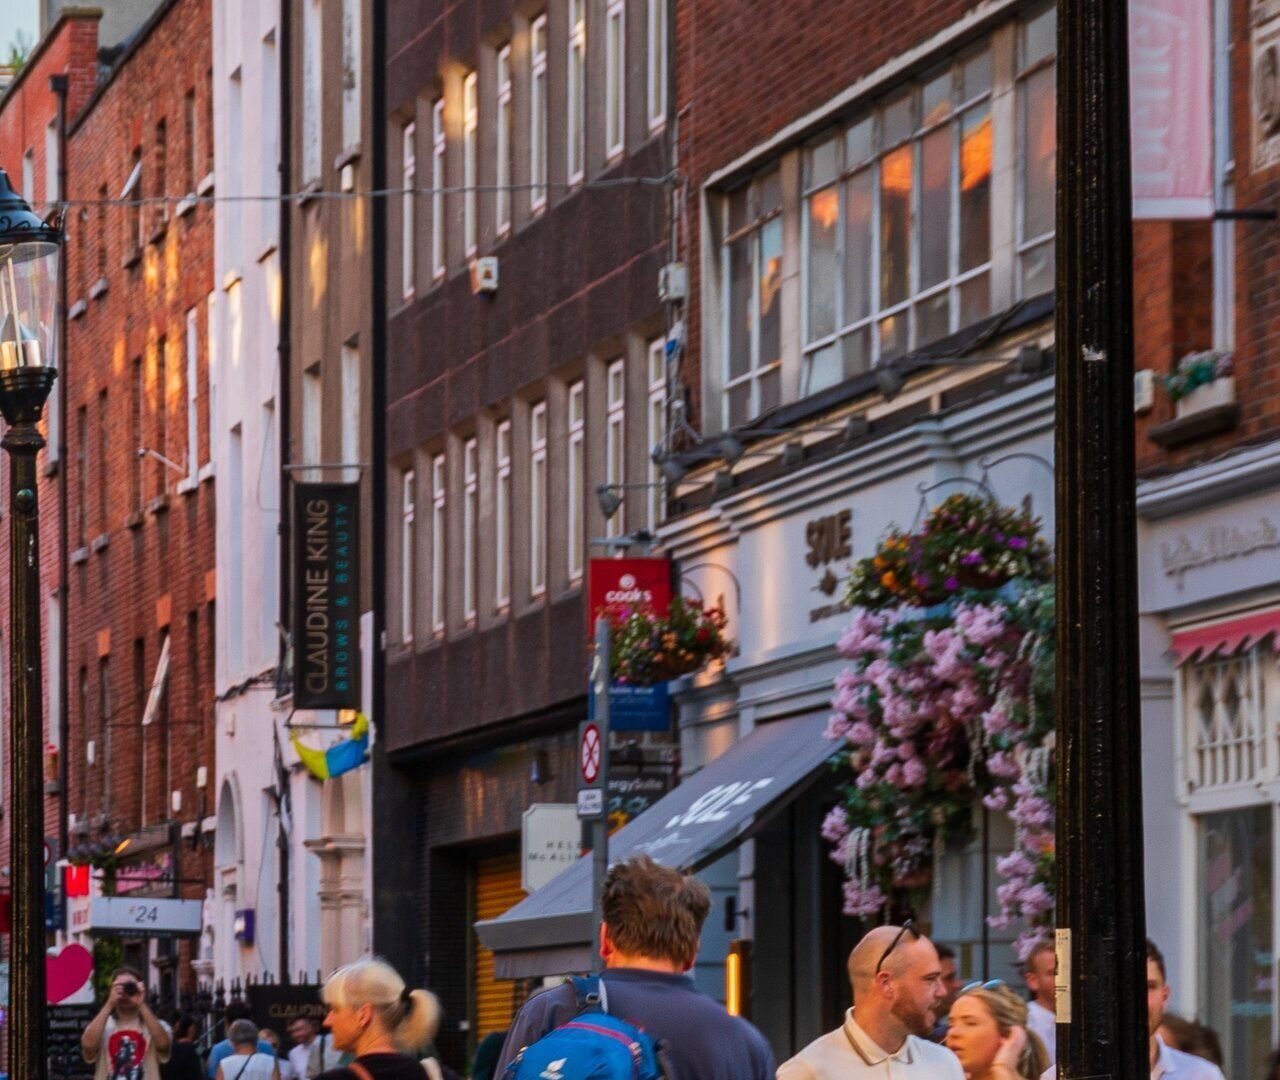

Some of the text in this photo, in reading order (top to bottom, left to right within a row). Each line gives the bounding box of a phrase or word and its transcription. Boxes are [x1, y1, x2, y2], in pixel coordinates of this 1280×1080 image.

[335, 503, 349, 584] BEAUTY
[605, 588, 653, 603] cooks
[335, 619, 349, 692] BROWS
